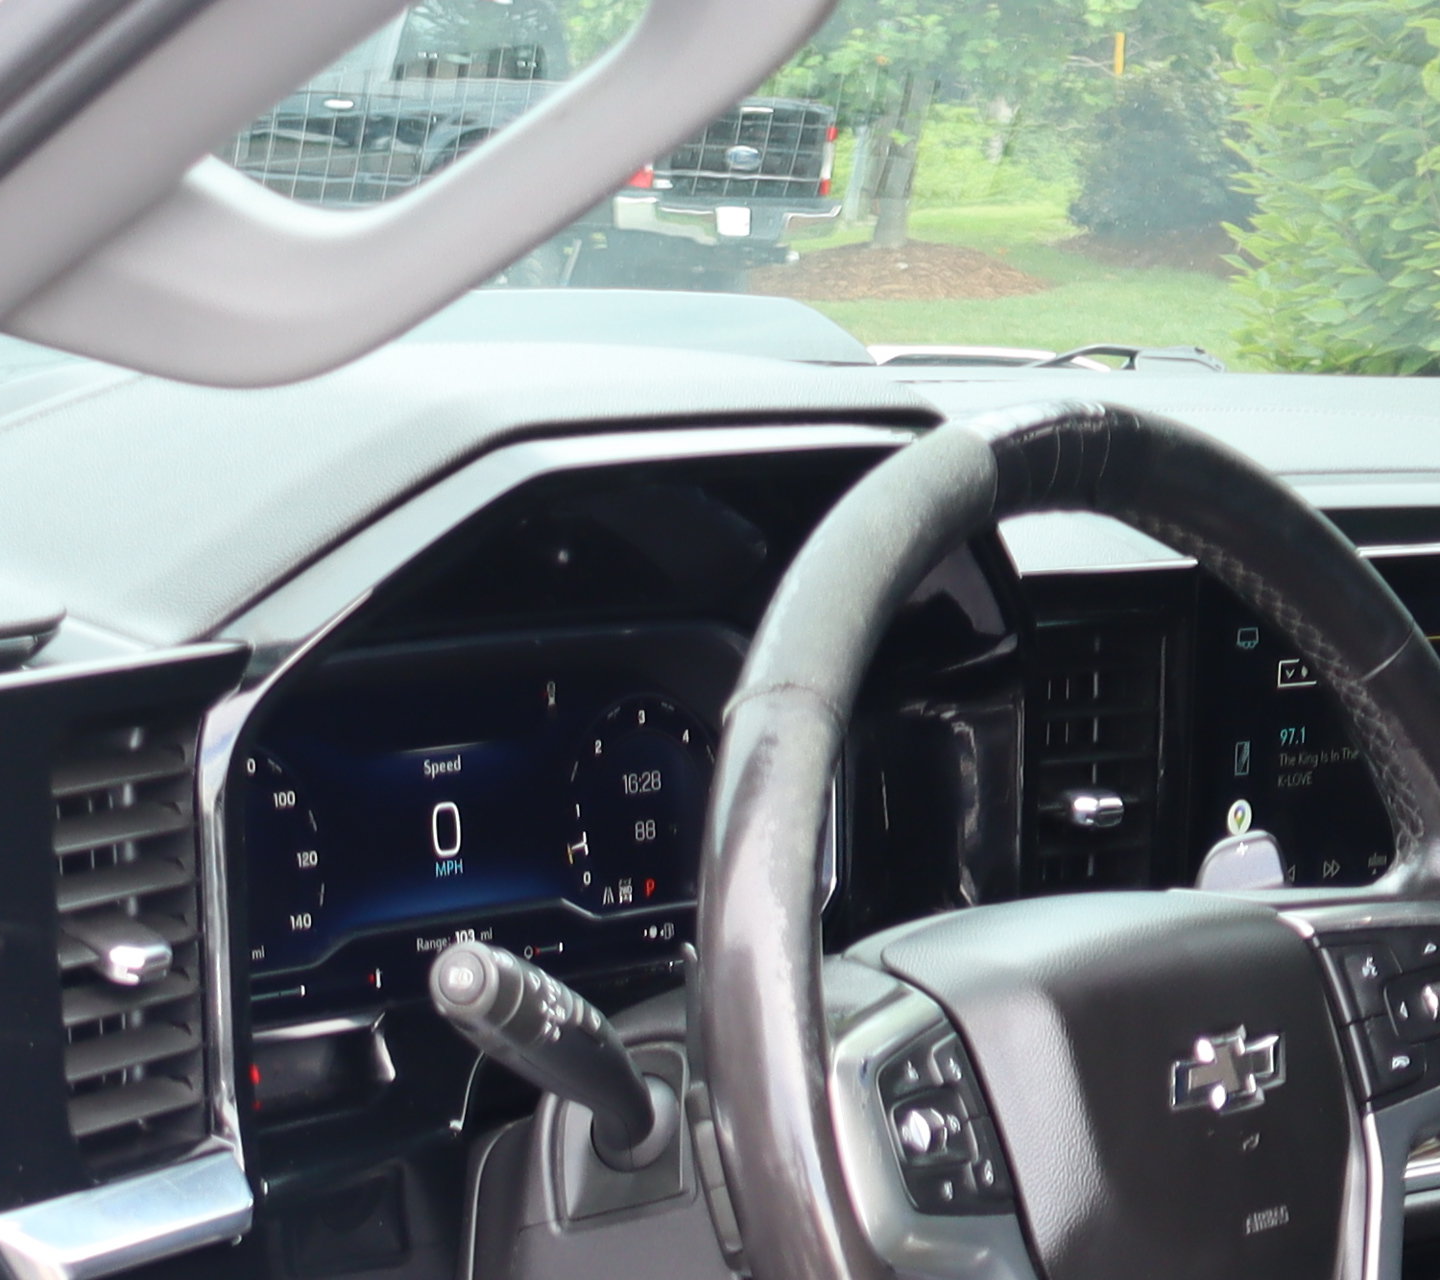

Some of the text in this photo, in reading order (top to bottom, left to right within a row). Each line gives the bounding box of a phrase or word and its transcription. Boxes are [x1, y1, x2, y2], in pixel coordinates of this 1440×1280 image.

[637, 709, 646, 725] 3
[681, 729, 690, 744] 4
[1279, 726, 1306, 746] 97.1
[594, 739, 603, 755] 2
[423, 754, 462, 779] Speed
[622, 770, 662, 795] 16:28
[273, 790, 296, 808] 100
[432, 801, 462, 858] 0
[296, 850, 319, 868] 120
[435, 858, 464, 878] MPH
[583, 871, 592, 886] 0
[645, 878, 656, 898] P
[290, 913, 312, 931] 140
